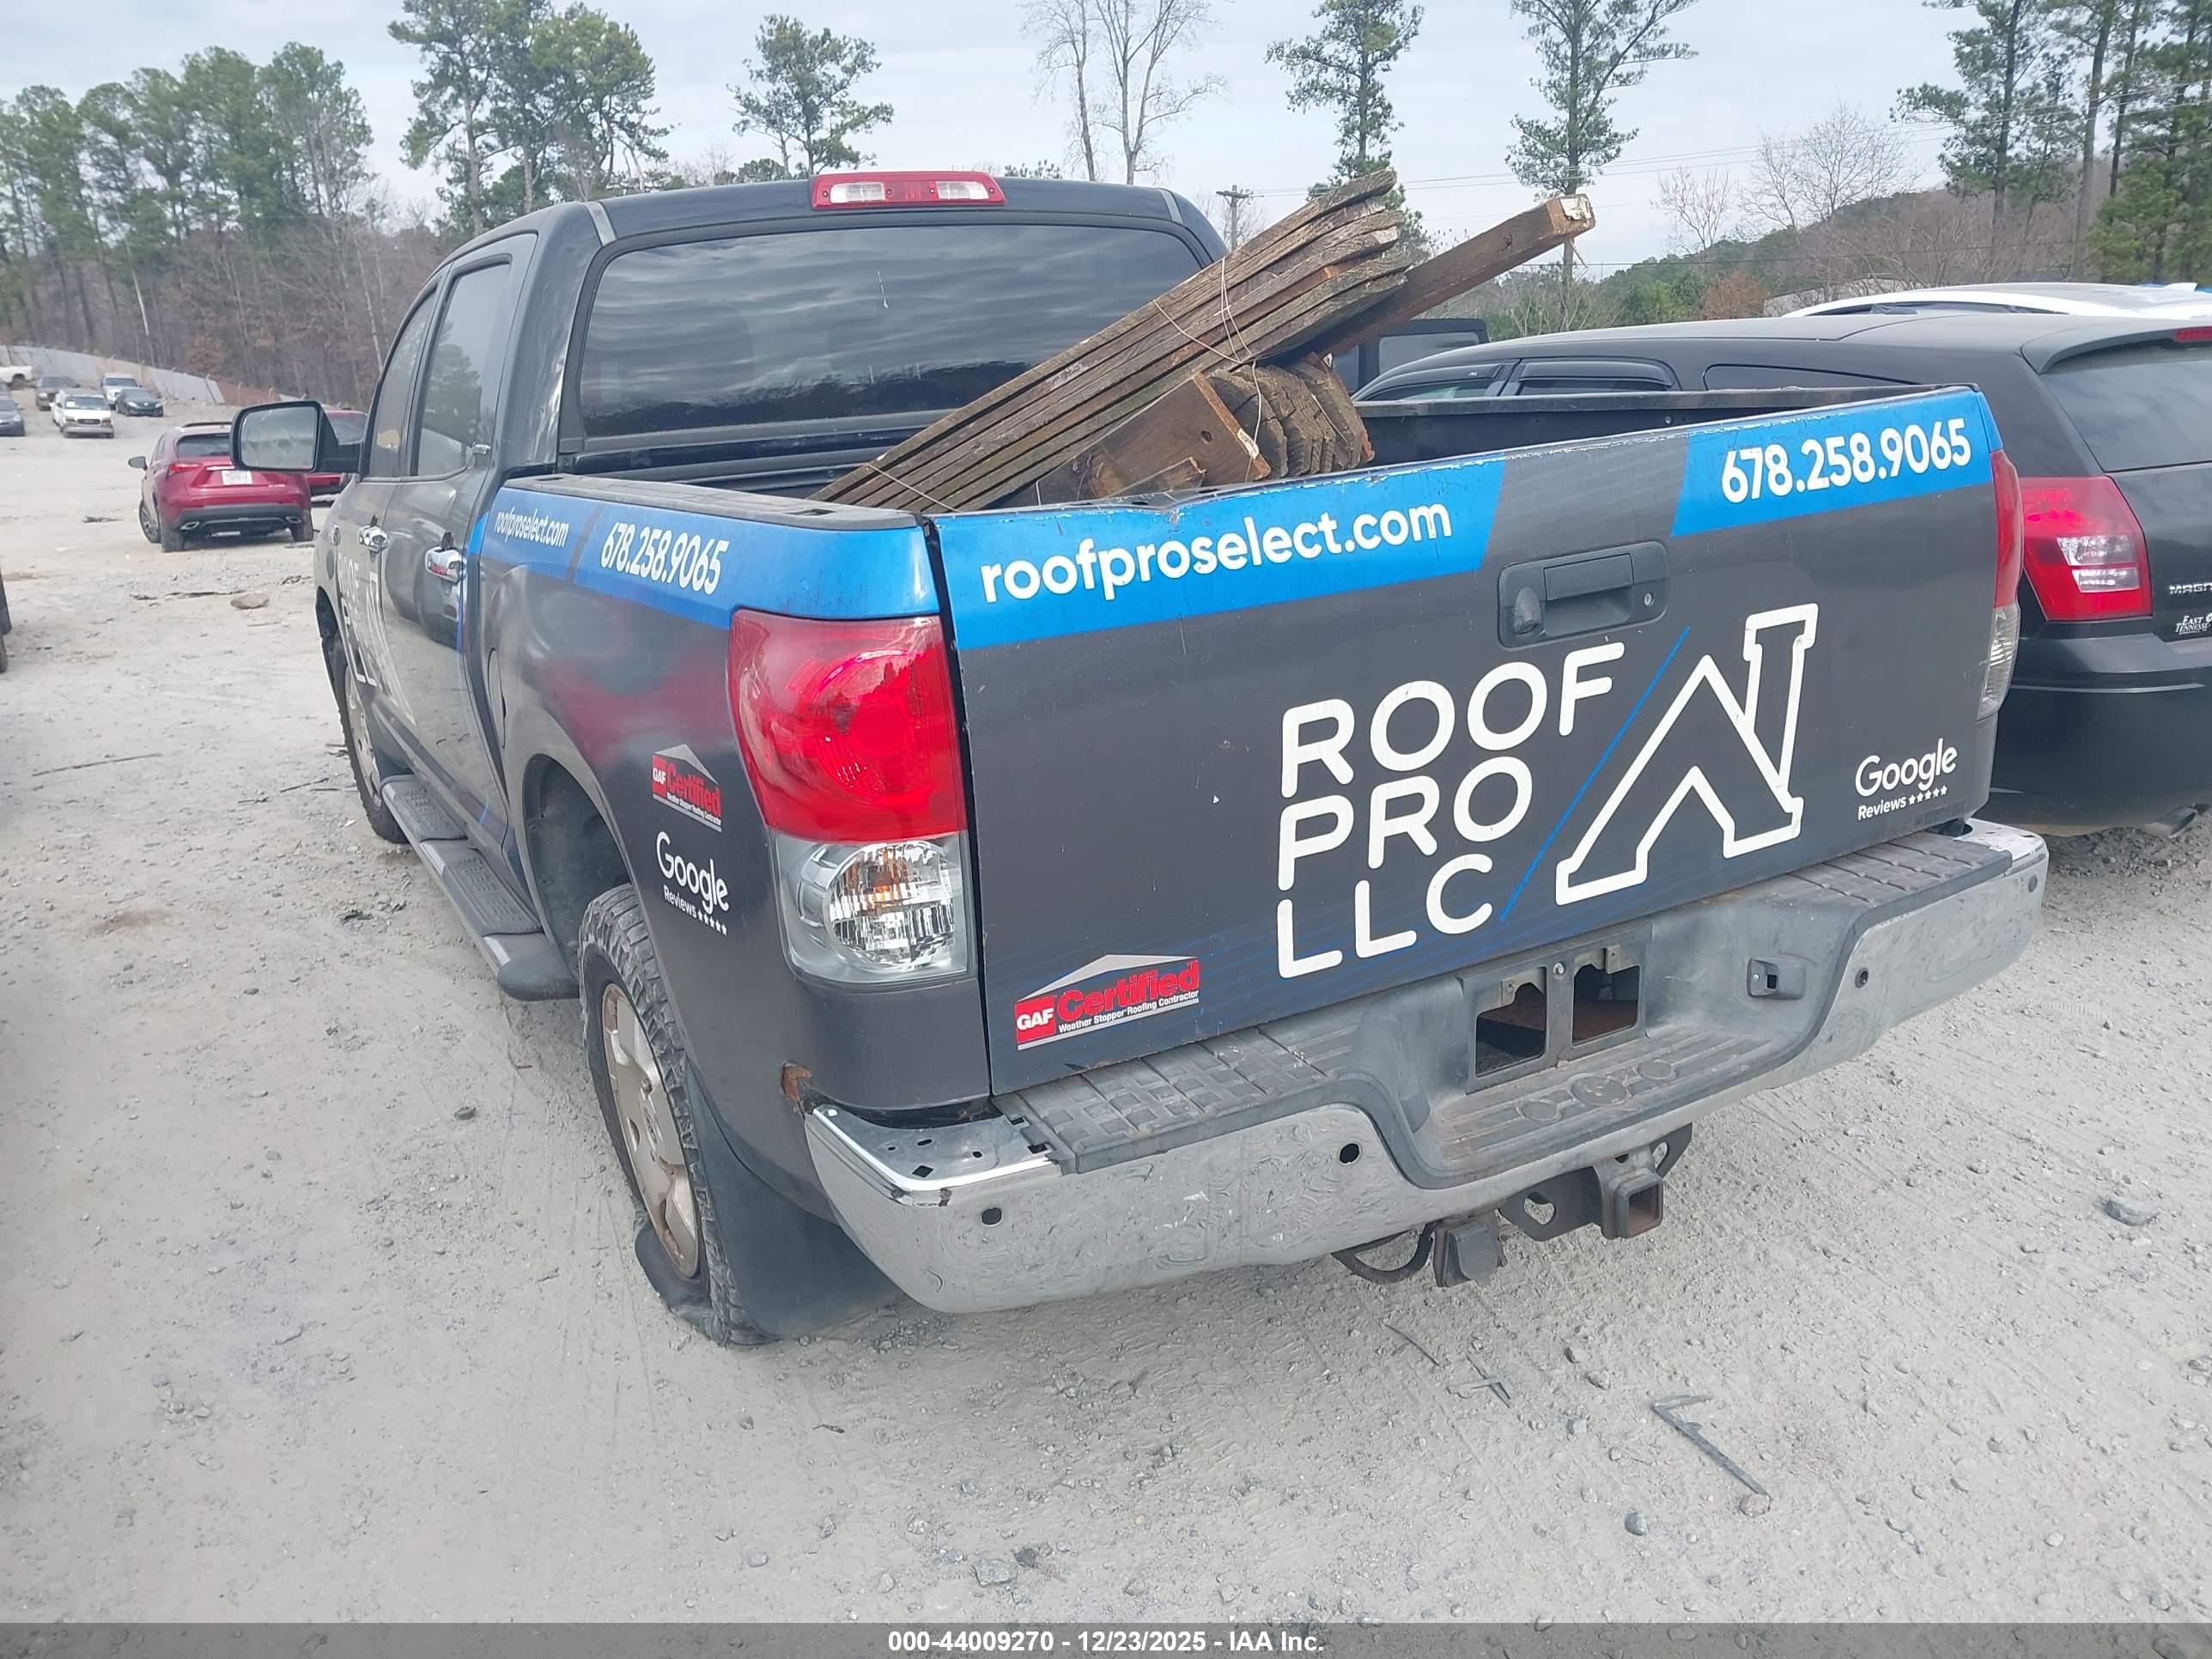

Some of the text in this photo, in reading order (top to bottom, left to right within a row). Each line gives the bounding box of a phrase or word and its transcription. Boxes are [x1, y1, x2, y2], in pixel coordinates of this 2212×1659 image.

[1722, 417, 1972, 503] 678.258.9065
[494, 507, 569, 549] roofproselect.com
[600, 521, 730, 596] 678.258.9065
[981, 501, 1453, 603] roofproselect.com
[1281, 641, 1626, 799] ROOF
[666, 763, 721, 817] Certified
[1855, 737, 1958, 798] Google
[1278, 756, 1533, 891] PRO
[1857, 796, 1907, 821] Reviews
[656, 830, 730, 915] Google
[663, 884, 697, 919] Reviews
[1277, 854, 1493, 979] LLC
[1017, 959, 1200, 1030] GAF Certified
[1059, 1018, 1092, 1033] Weather
[1127, 1001, 1158, 1016] Roofing
[1158, 989, 1200, 1006] Contractor
